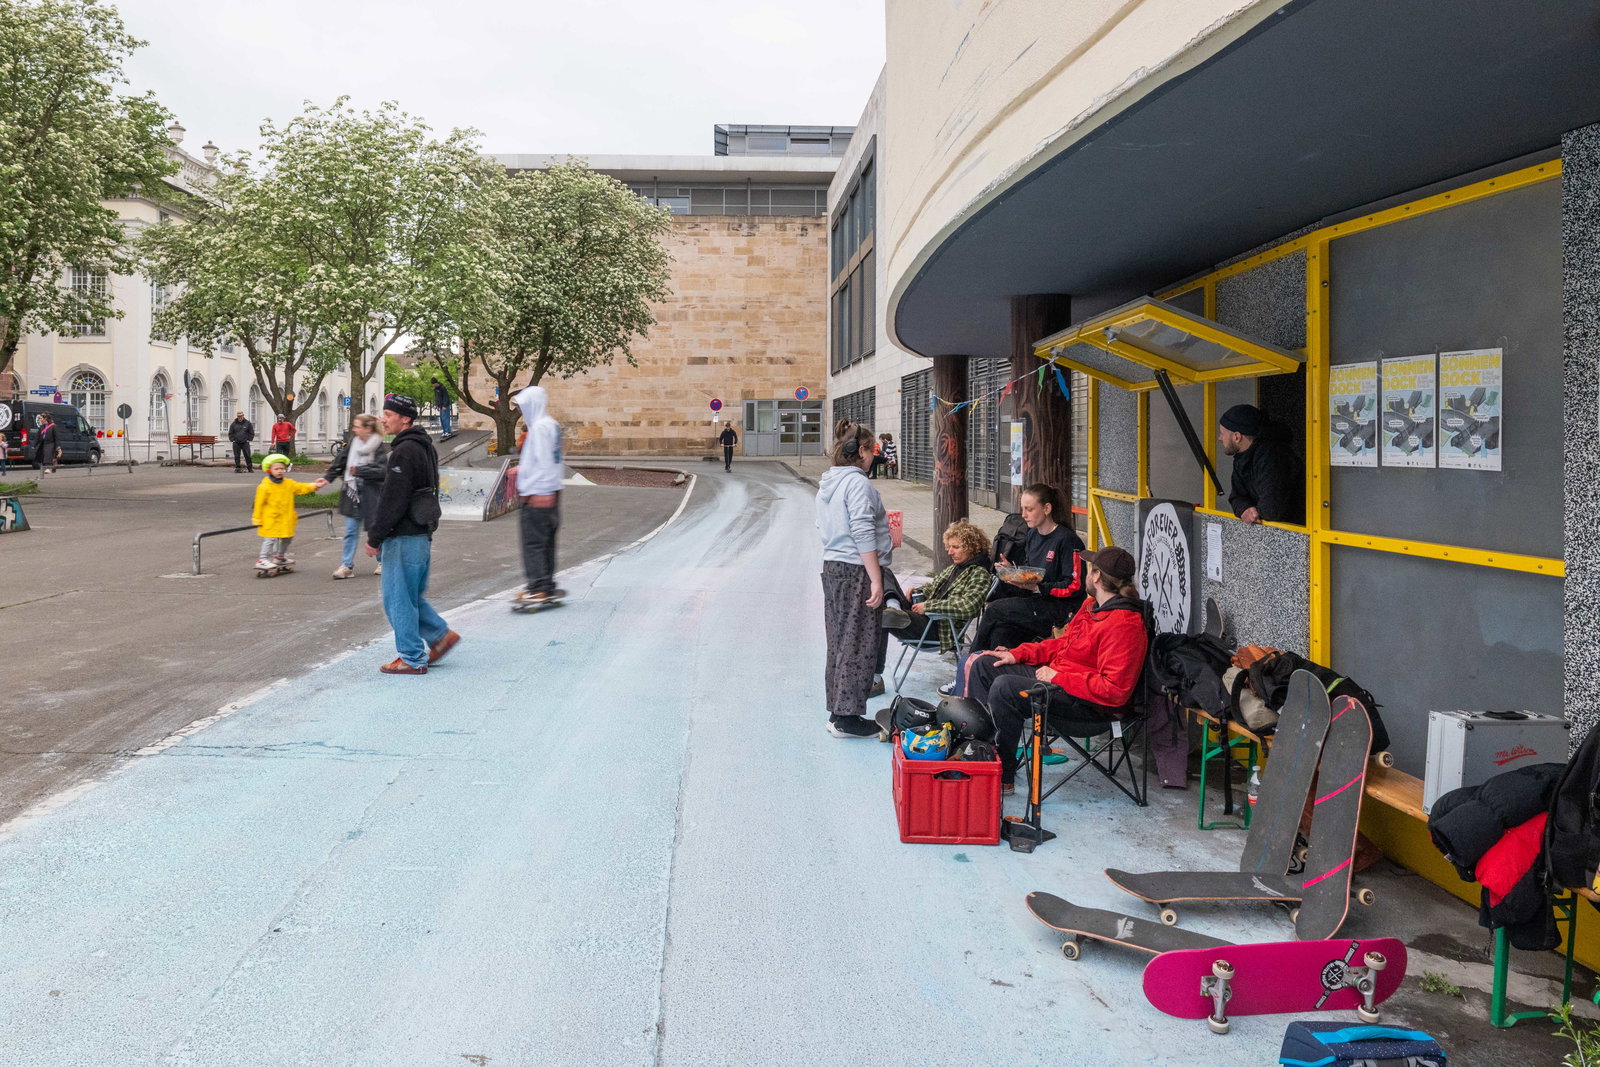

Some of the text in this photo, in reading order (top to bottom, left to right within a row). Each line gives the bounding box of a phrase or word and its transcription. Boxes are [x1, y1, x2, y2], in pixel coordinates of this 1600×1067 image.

[1383, 376, 1417, 390] DOCK
[1441, 371, 1481, 386] DOCK
[1330, 381, 1361, 395] DOCK
[1147, 514, 1177, 547] FOREVER
